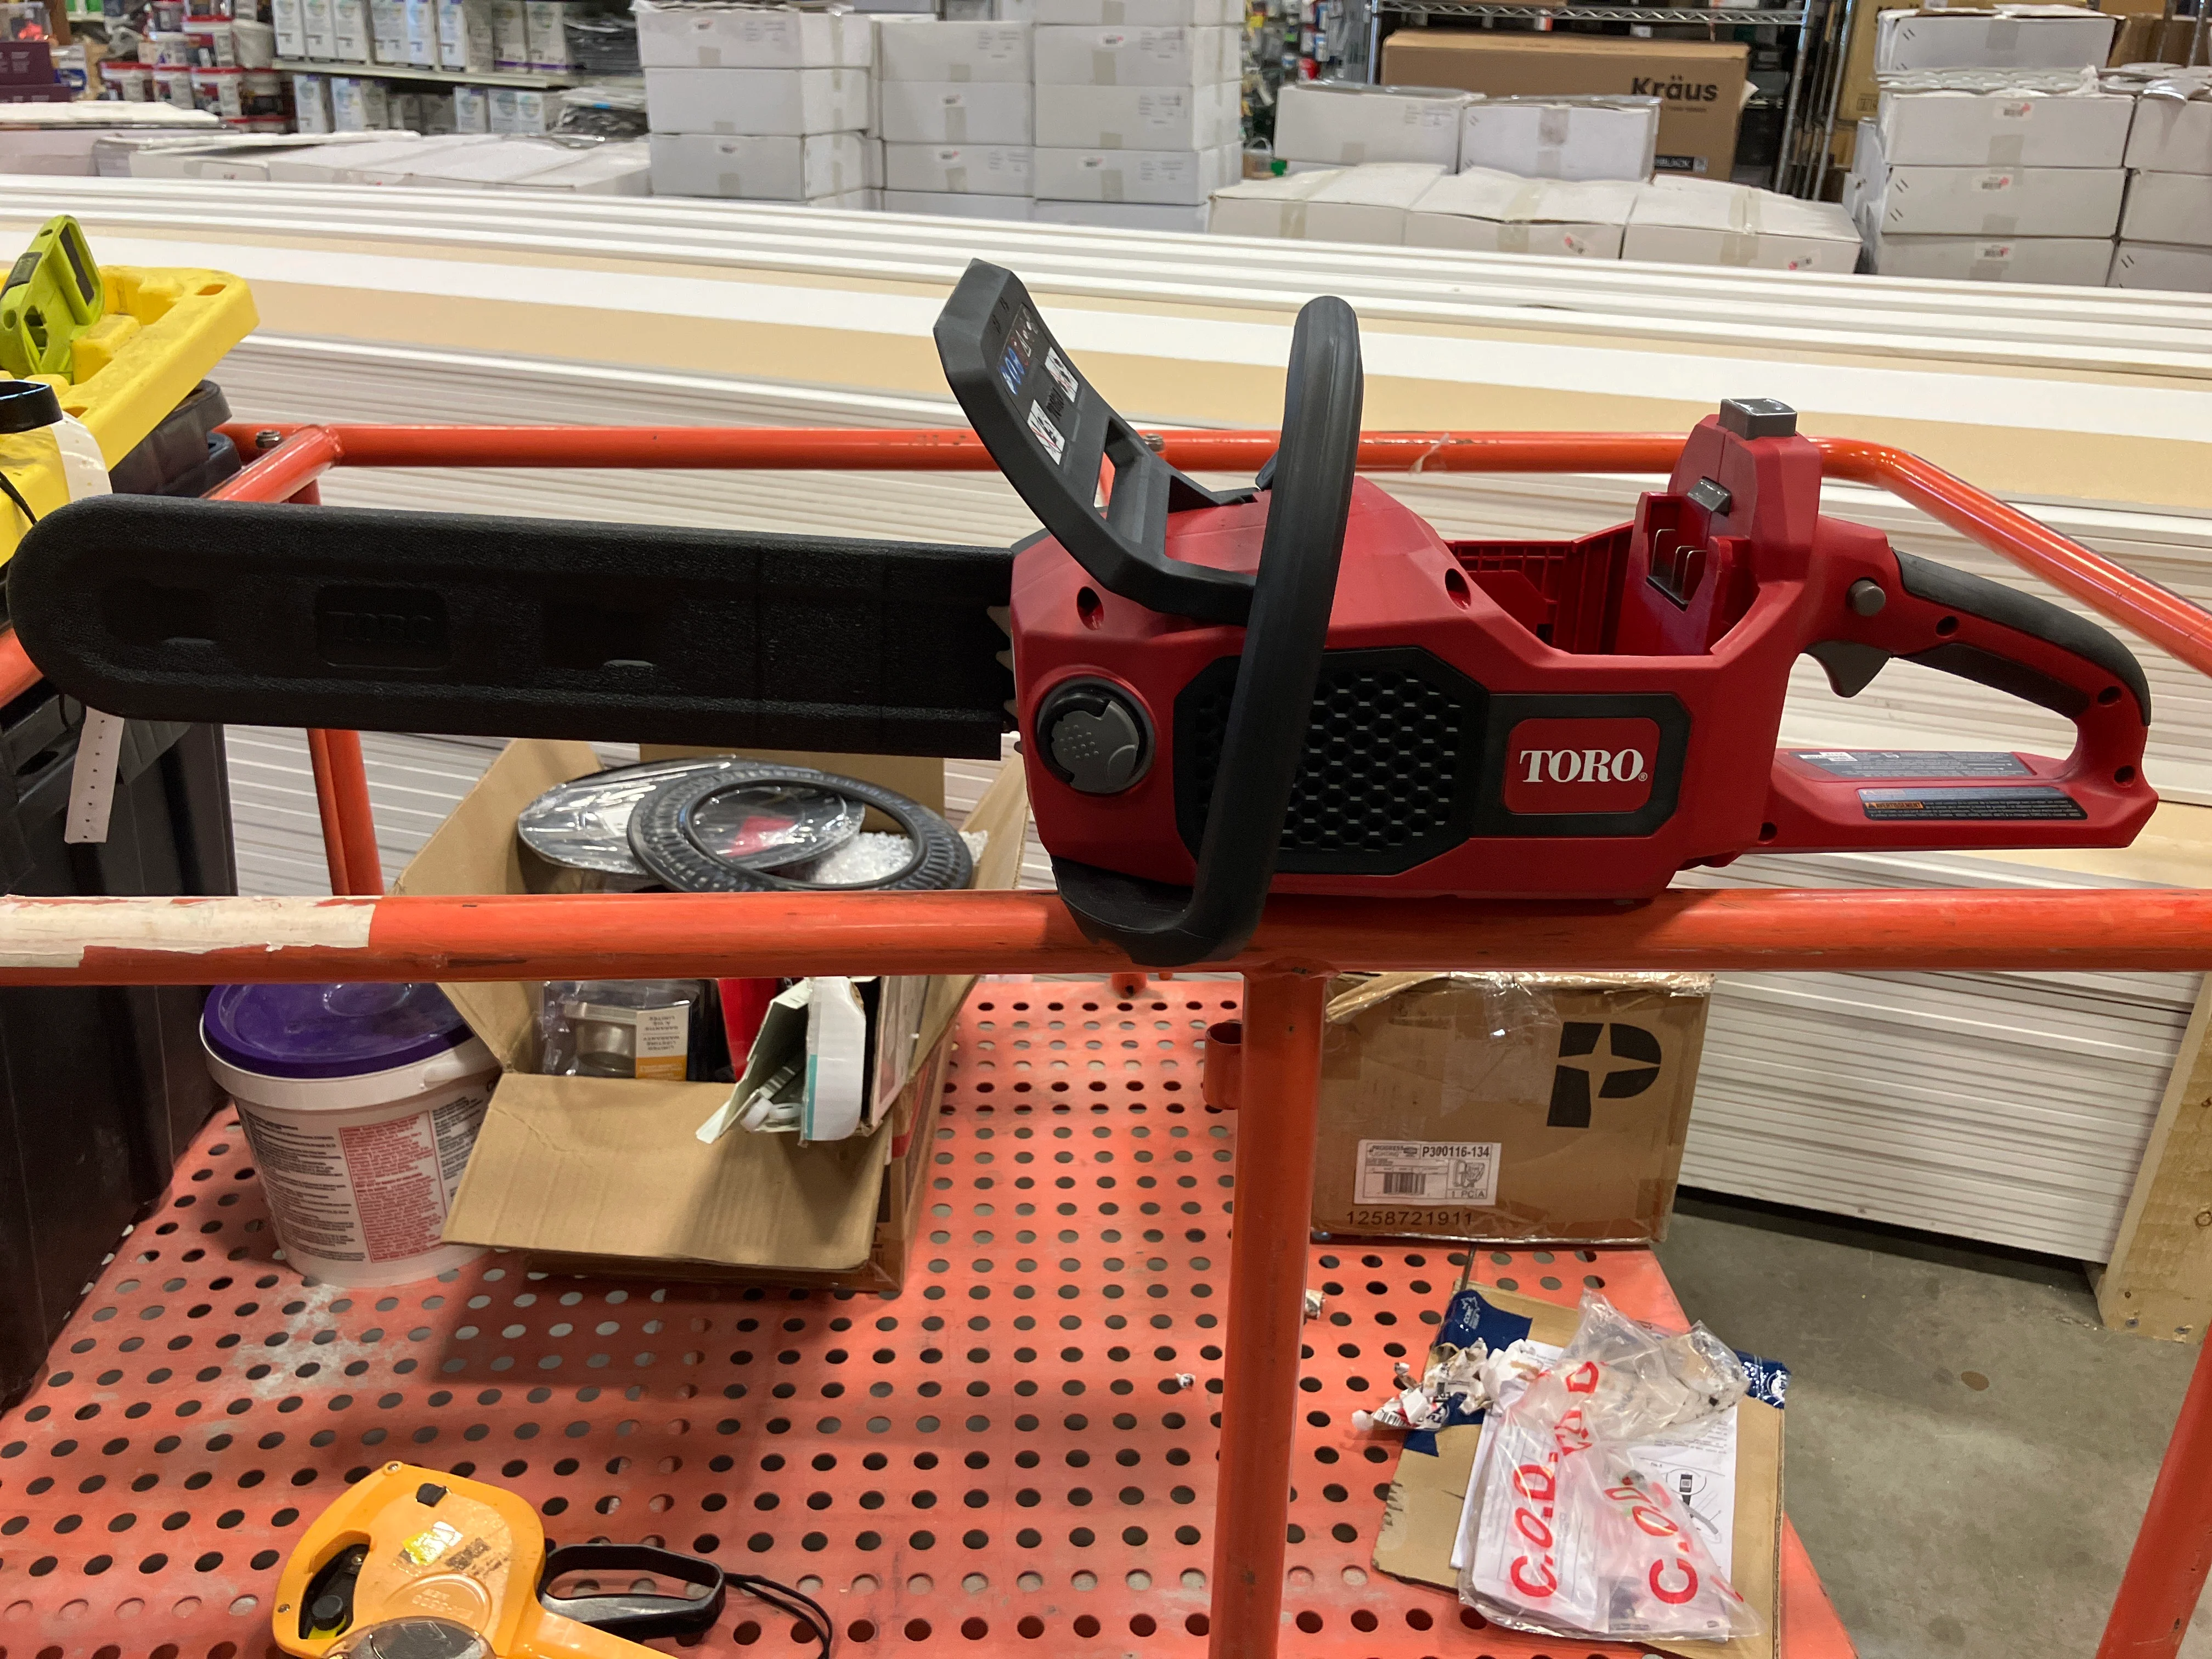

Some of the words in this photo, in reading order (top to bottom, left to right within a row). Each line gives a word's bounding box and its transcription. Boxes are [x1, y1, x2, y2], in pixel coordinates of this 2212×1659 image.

[1632, 75, 1718, 101] Kräus
[1422, 1146, 1489, 1158] P300116-134
[1346, 1211, 1474, 1226] 1258721911
